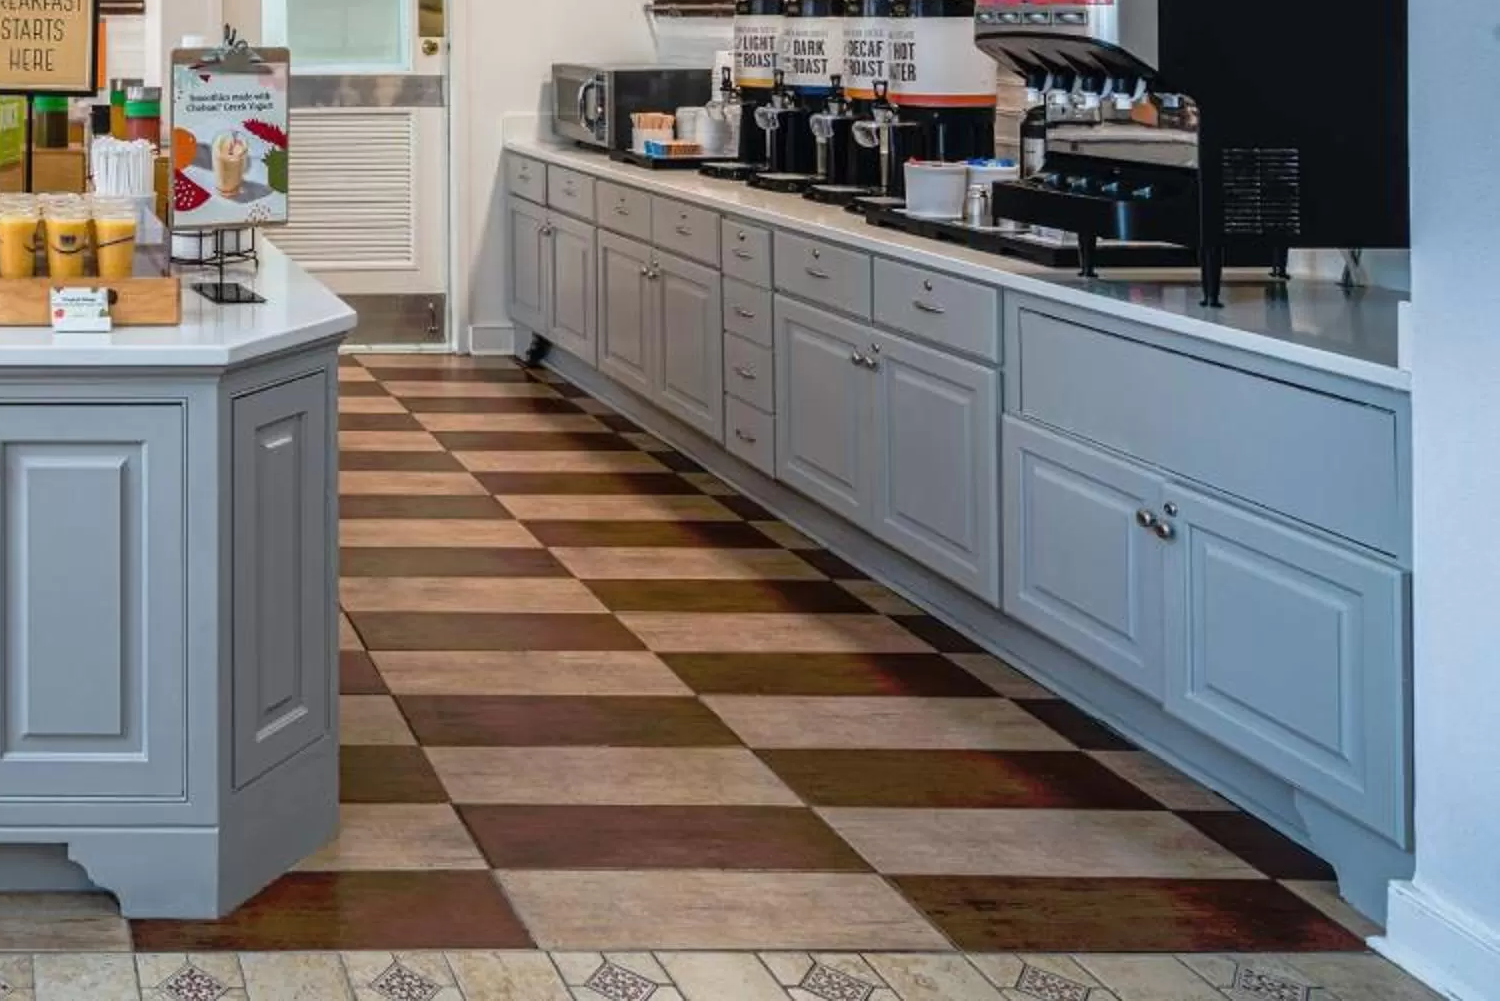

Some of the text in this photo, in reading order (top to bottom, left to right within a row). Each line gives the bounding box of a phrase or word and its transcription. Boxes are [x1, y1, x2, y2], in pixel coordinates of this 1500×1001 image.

[0, 17, 65, 41] STARTS
[743, 35, 775, 51] LIGHT
[793, 39, 825, 56] DARK
[847, 40, 884, 57] DECAF
[893, 42, 916, 60] HOT
[9, 47, 56, 72] HERE
[743, 52, 779, 68] ROAST
